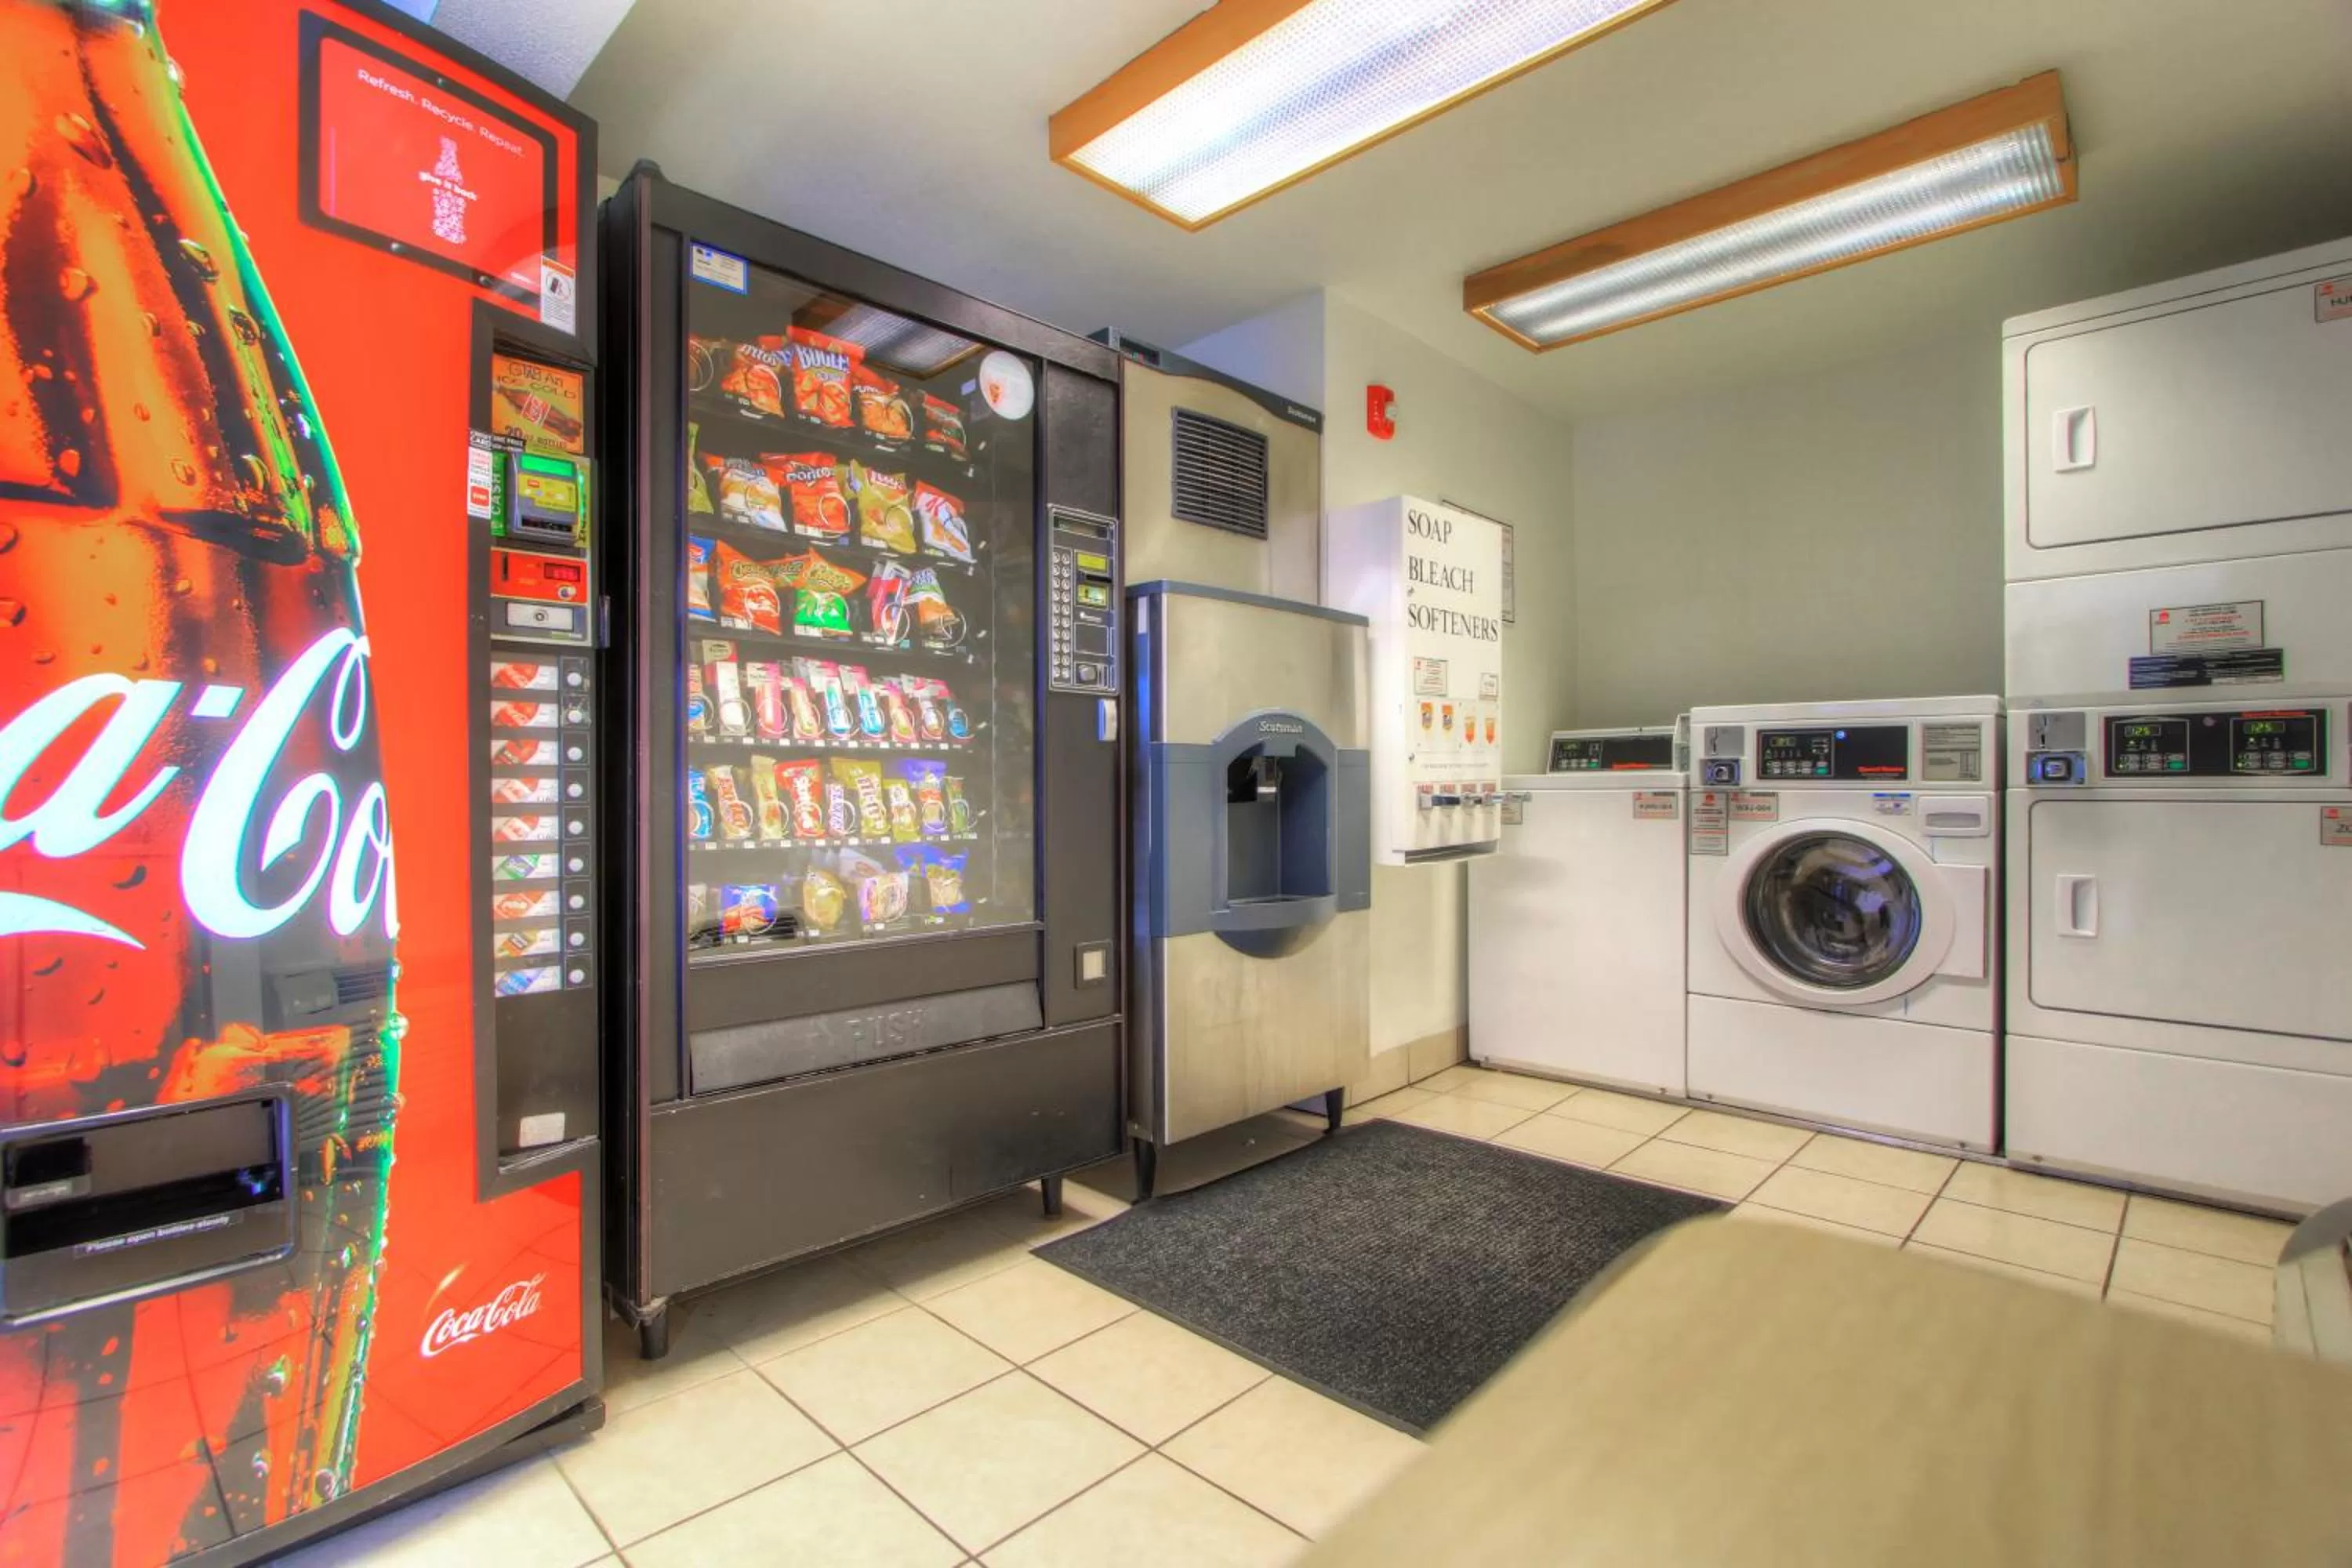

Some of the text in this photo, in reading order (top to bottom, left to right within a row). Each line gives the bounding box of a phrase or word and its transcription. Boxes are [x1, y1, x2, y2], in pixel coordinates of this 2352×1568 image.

[492, 472, 503, 516] CASH
[1407, 510, 1452, 544] SOAP
[1408, 555, 1474, 594] BLEACH
[1407, 603, 1499, 643] SOFTENERS
[1258, 720, 1303, 734] Scotsman
